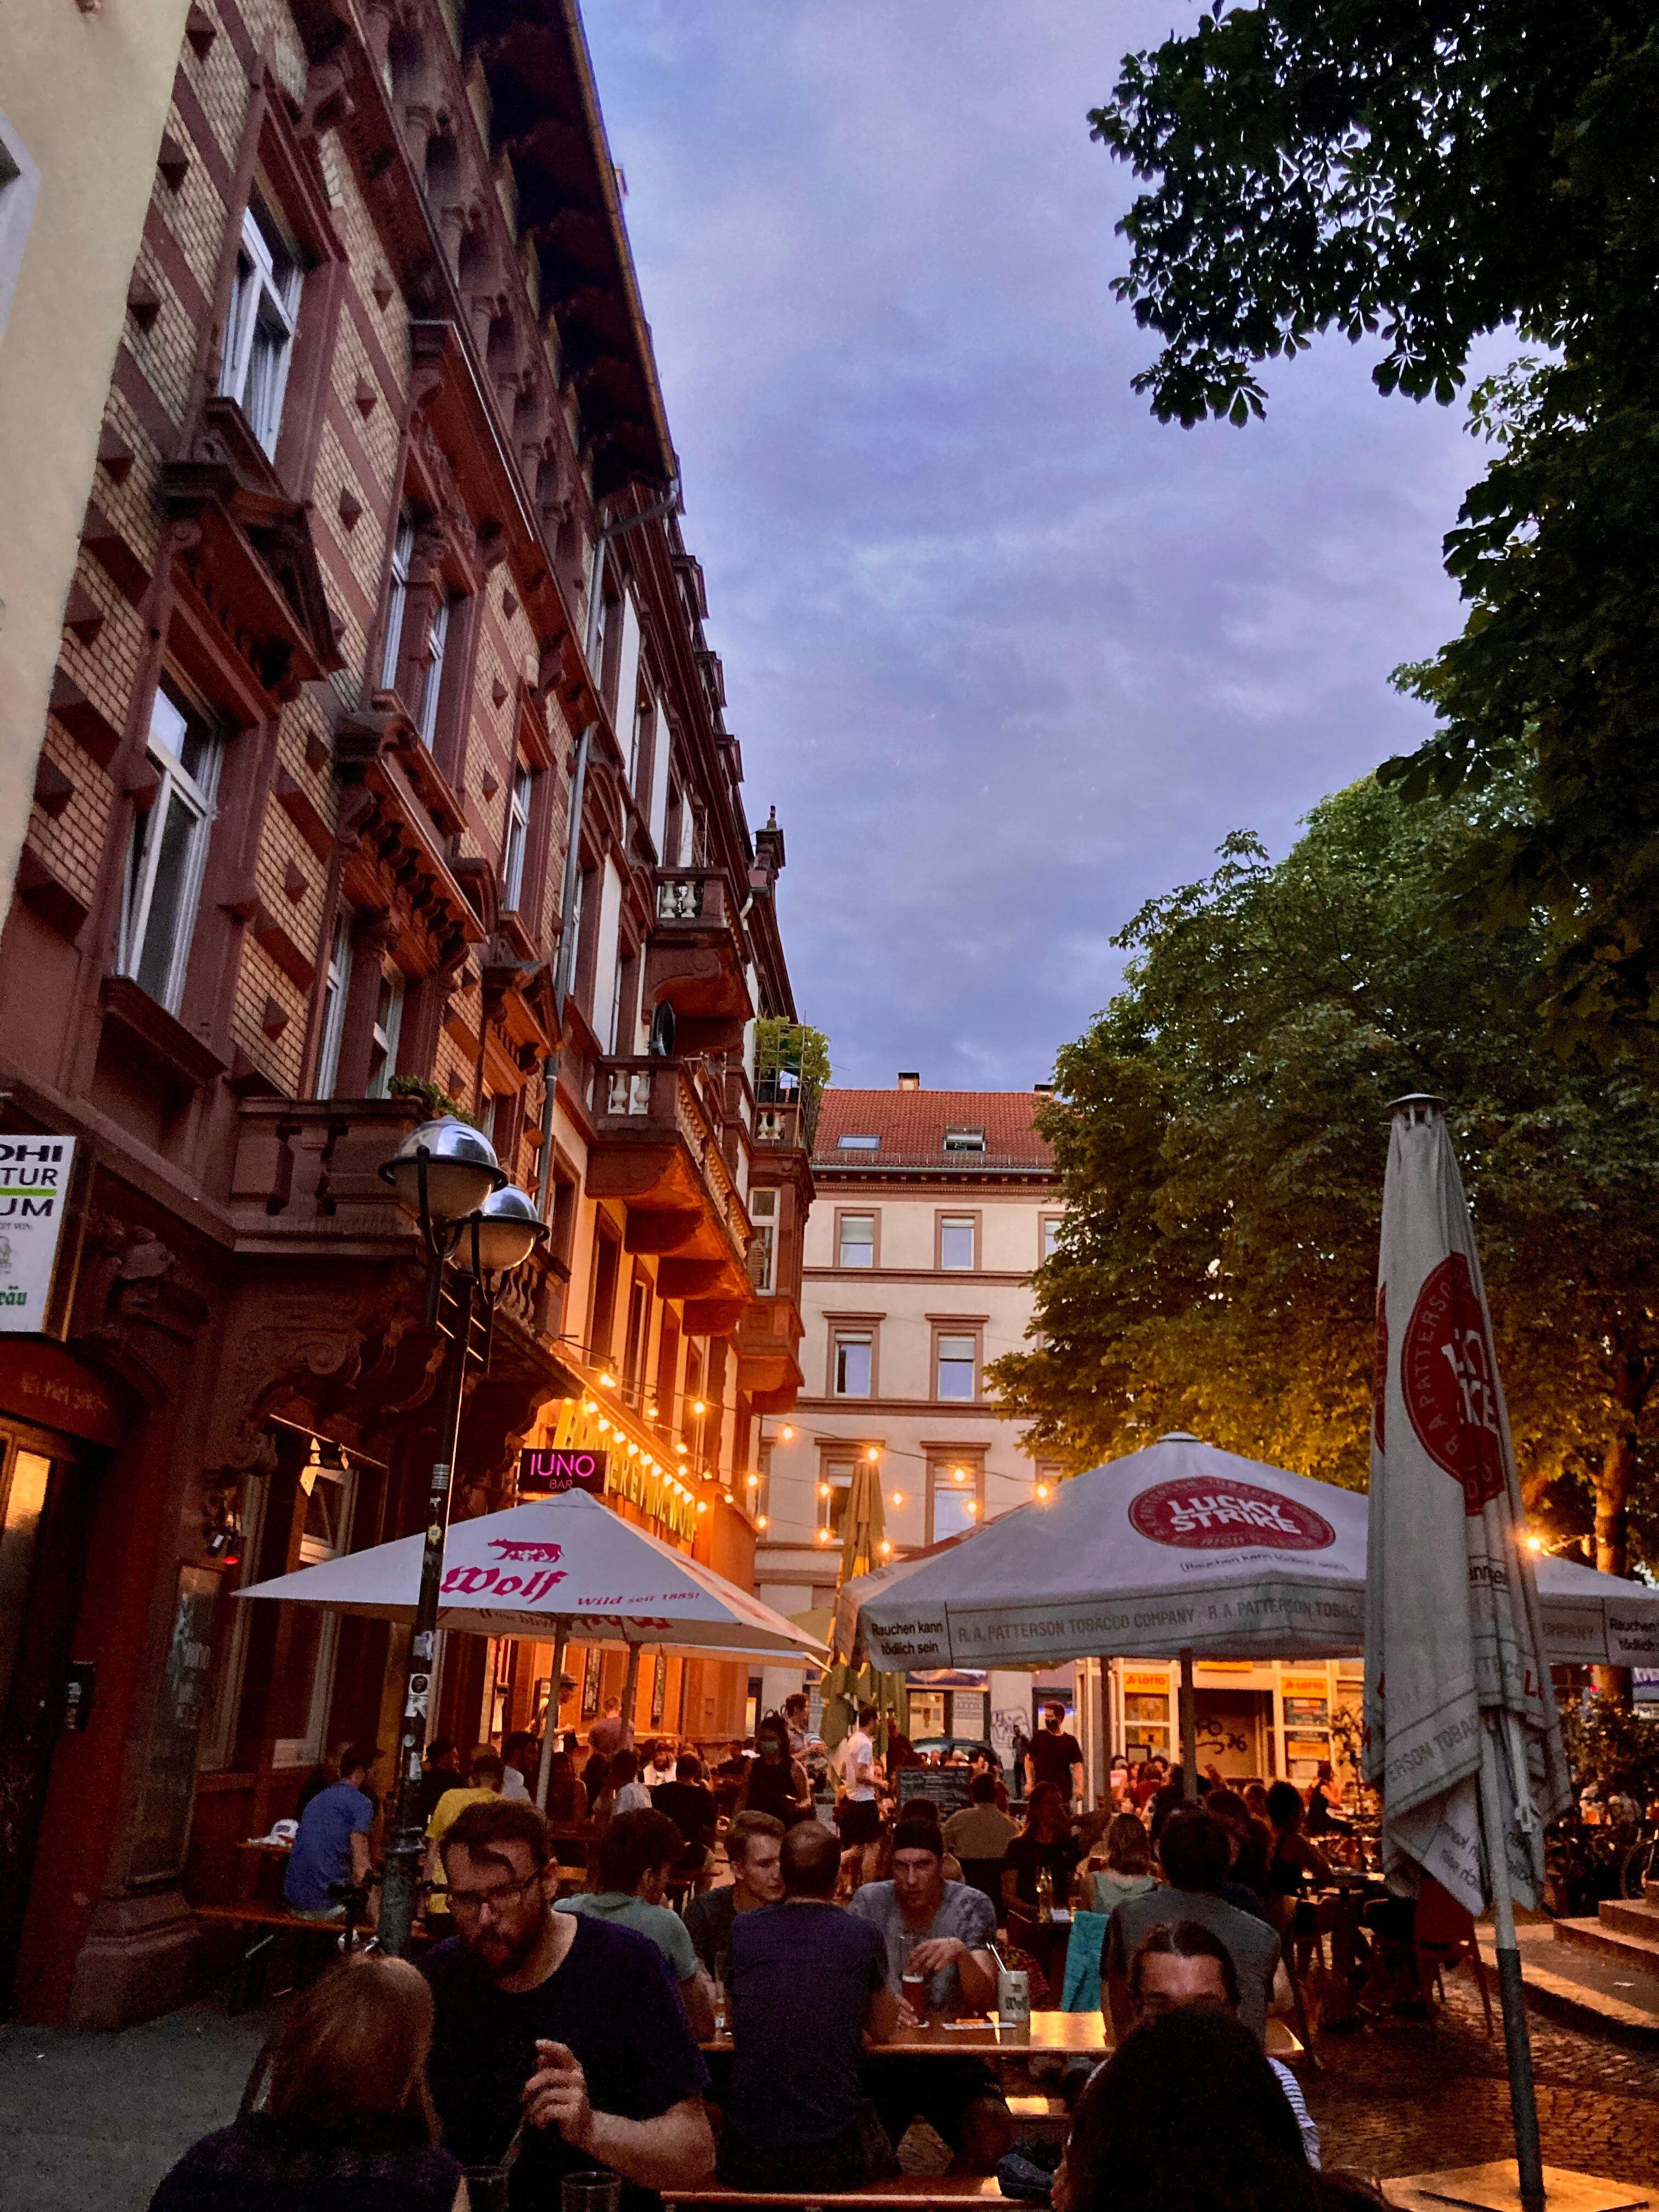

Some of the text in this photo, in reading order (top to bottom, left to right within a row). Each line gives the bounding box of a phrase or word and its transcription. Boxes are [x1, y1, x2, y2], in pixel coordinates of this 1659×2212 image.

[549, 1479, 573, 1489] BAR
[1167, 1494, 1281, 1518] LUCKY
[1170, 1509, 1301, 1534] STRIKE
[439, 1565, 570, 1604] Wolf
[578, 1595, 623, 1607] Wild
[988, 1620, 1065, 1641] PATTERSON
[1069, 1614, 1130, 1635] TOBACCO
[1133, 1606, 1194, 1628] COMPANY
[1237, 1598, 1312, 1617] PATTERSON
[872, 1621, 943, 1637] Rauchen kann
[881, 1640, 939, 1656] tödlich sein
[1138, 1675, 1166, 1686] LOTTO
[1296, 1680, 1325, 1691] LOTTO
